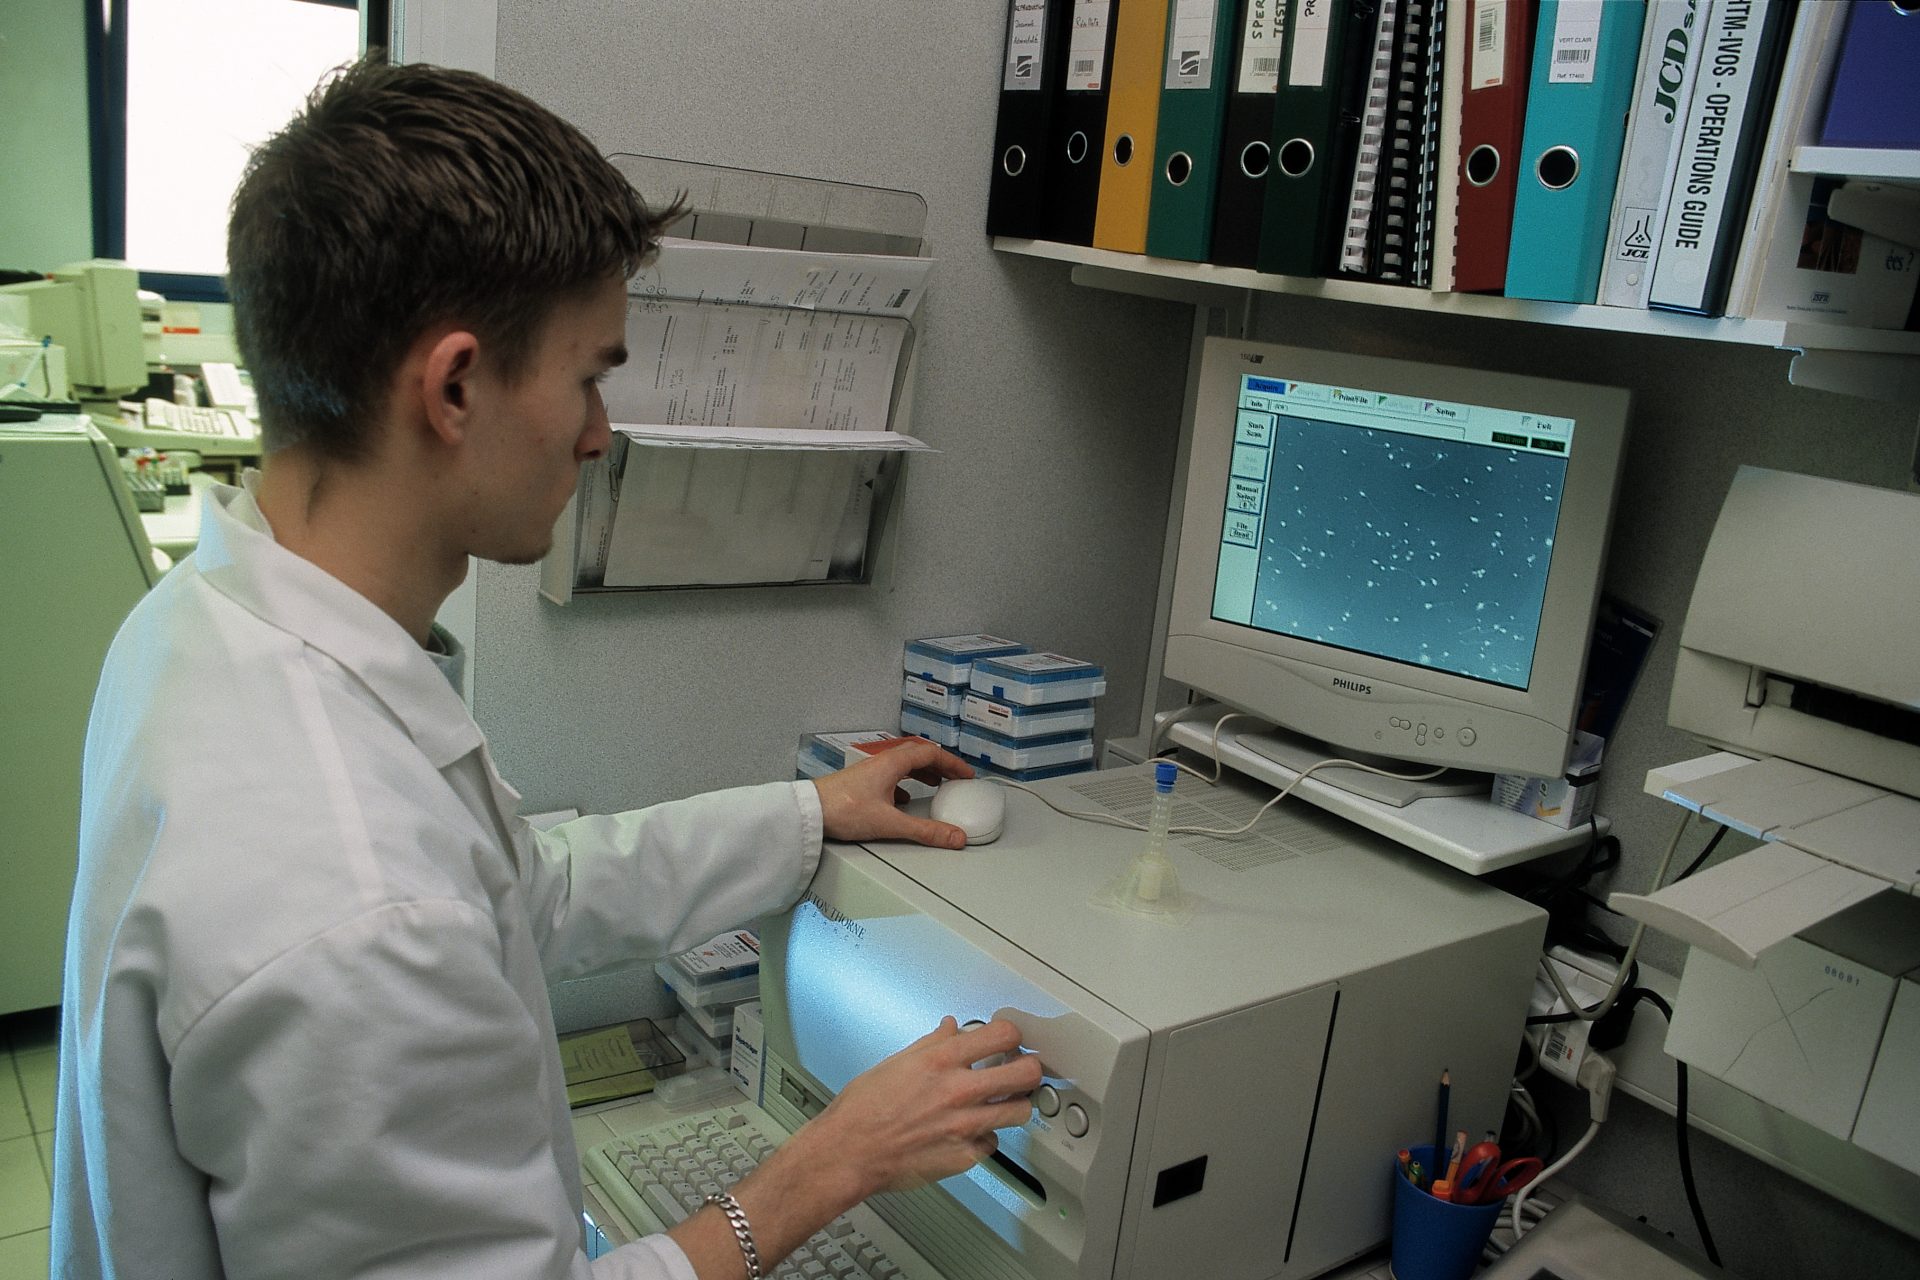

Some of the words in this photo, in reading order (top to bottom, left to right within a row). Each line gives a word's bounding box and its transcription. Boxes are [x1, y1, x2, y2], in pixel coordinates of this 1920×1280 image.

[1654, 28, 1688, 124] JCD
[1686, 94, 1731, 195] OPERATIONS
[1675, 201, 1707, 249] GUIDE
[1333, 677, 1372, 695] PHILIPS
[830, 905, 866, 940] THORNE
